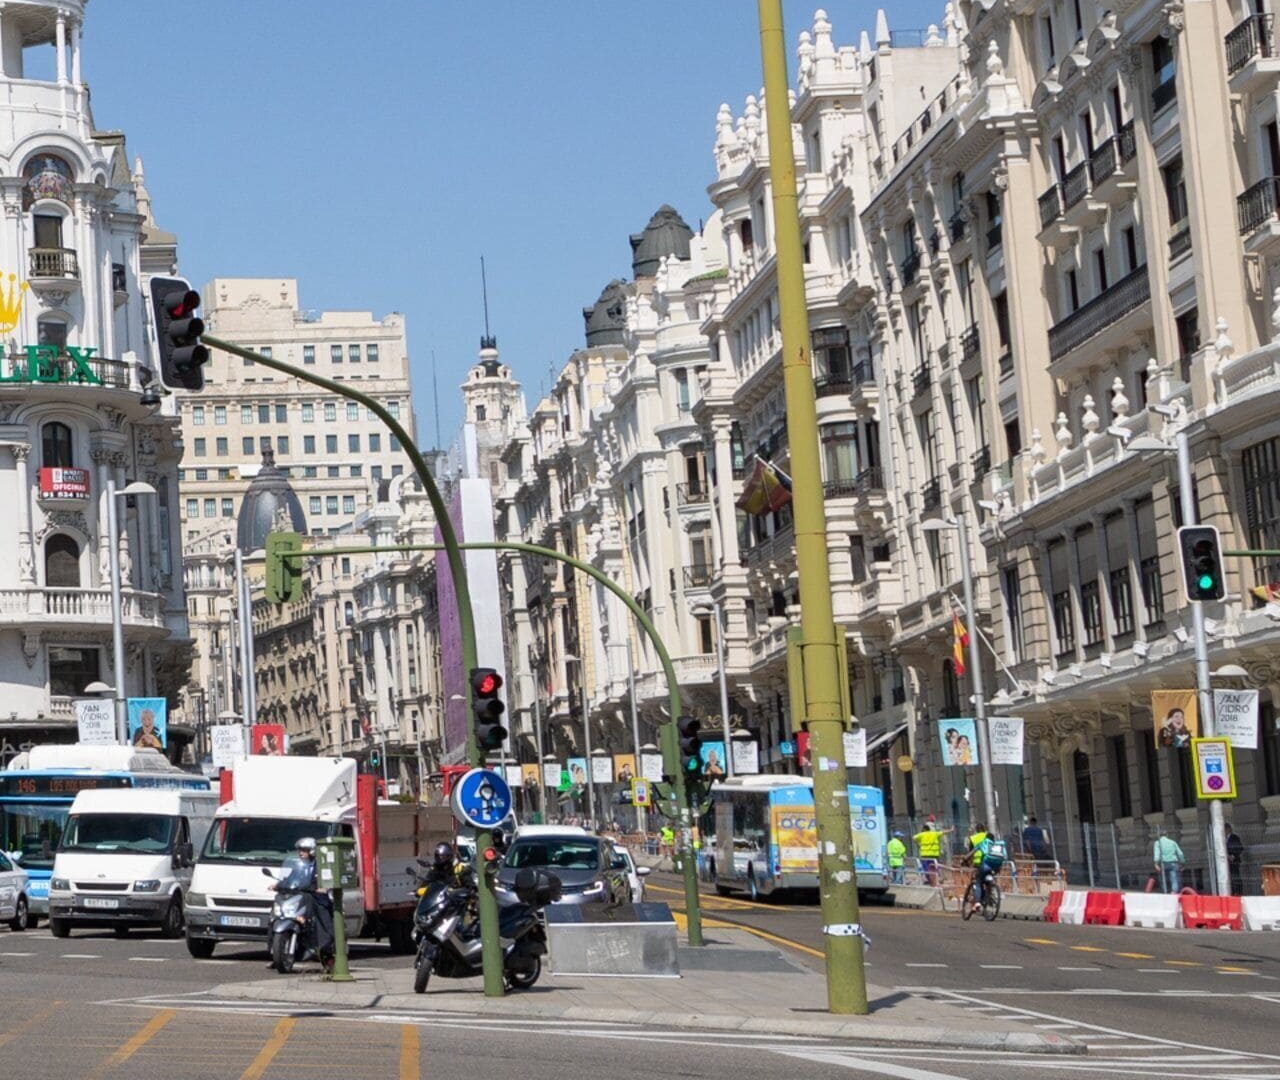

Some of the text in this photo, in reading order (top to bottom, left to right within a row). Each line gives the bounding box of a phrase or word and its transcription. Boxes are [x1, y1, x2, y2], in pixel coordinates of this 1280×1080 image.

[1220, 695, 1239, 705] SAN
[82, 704, 100, 715] SAN
[1220, 714, 1239, 722] 2018
[17, 779, 36, 793] 146
